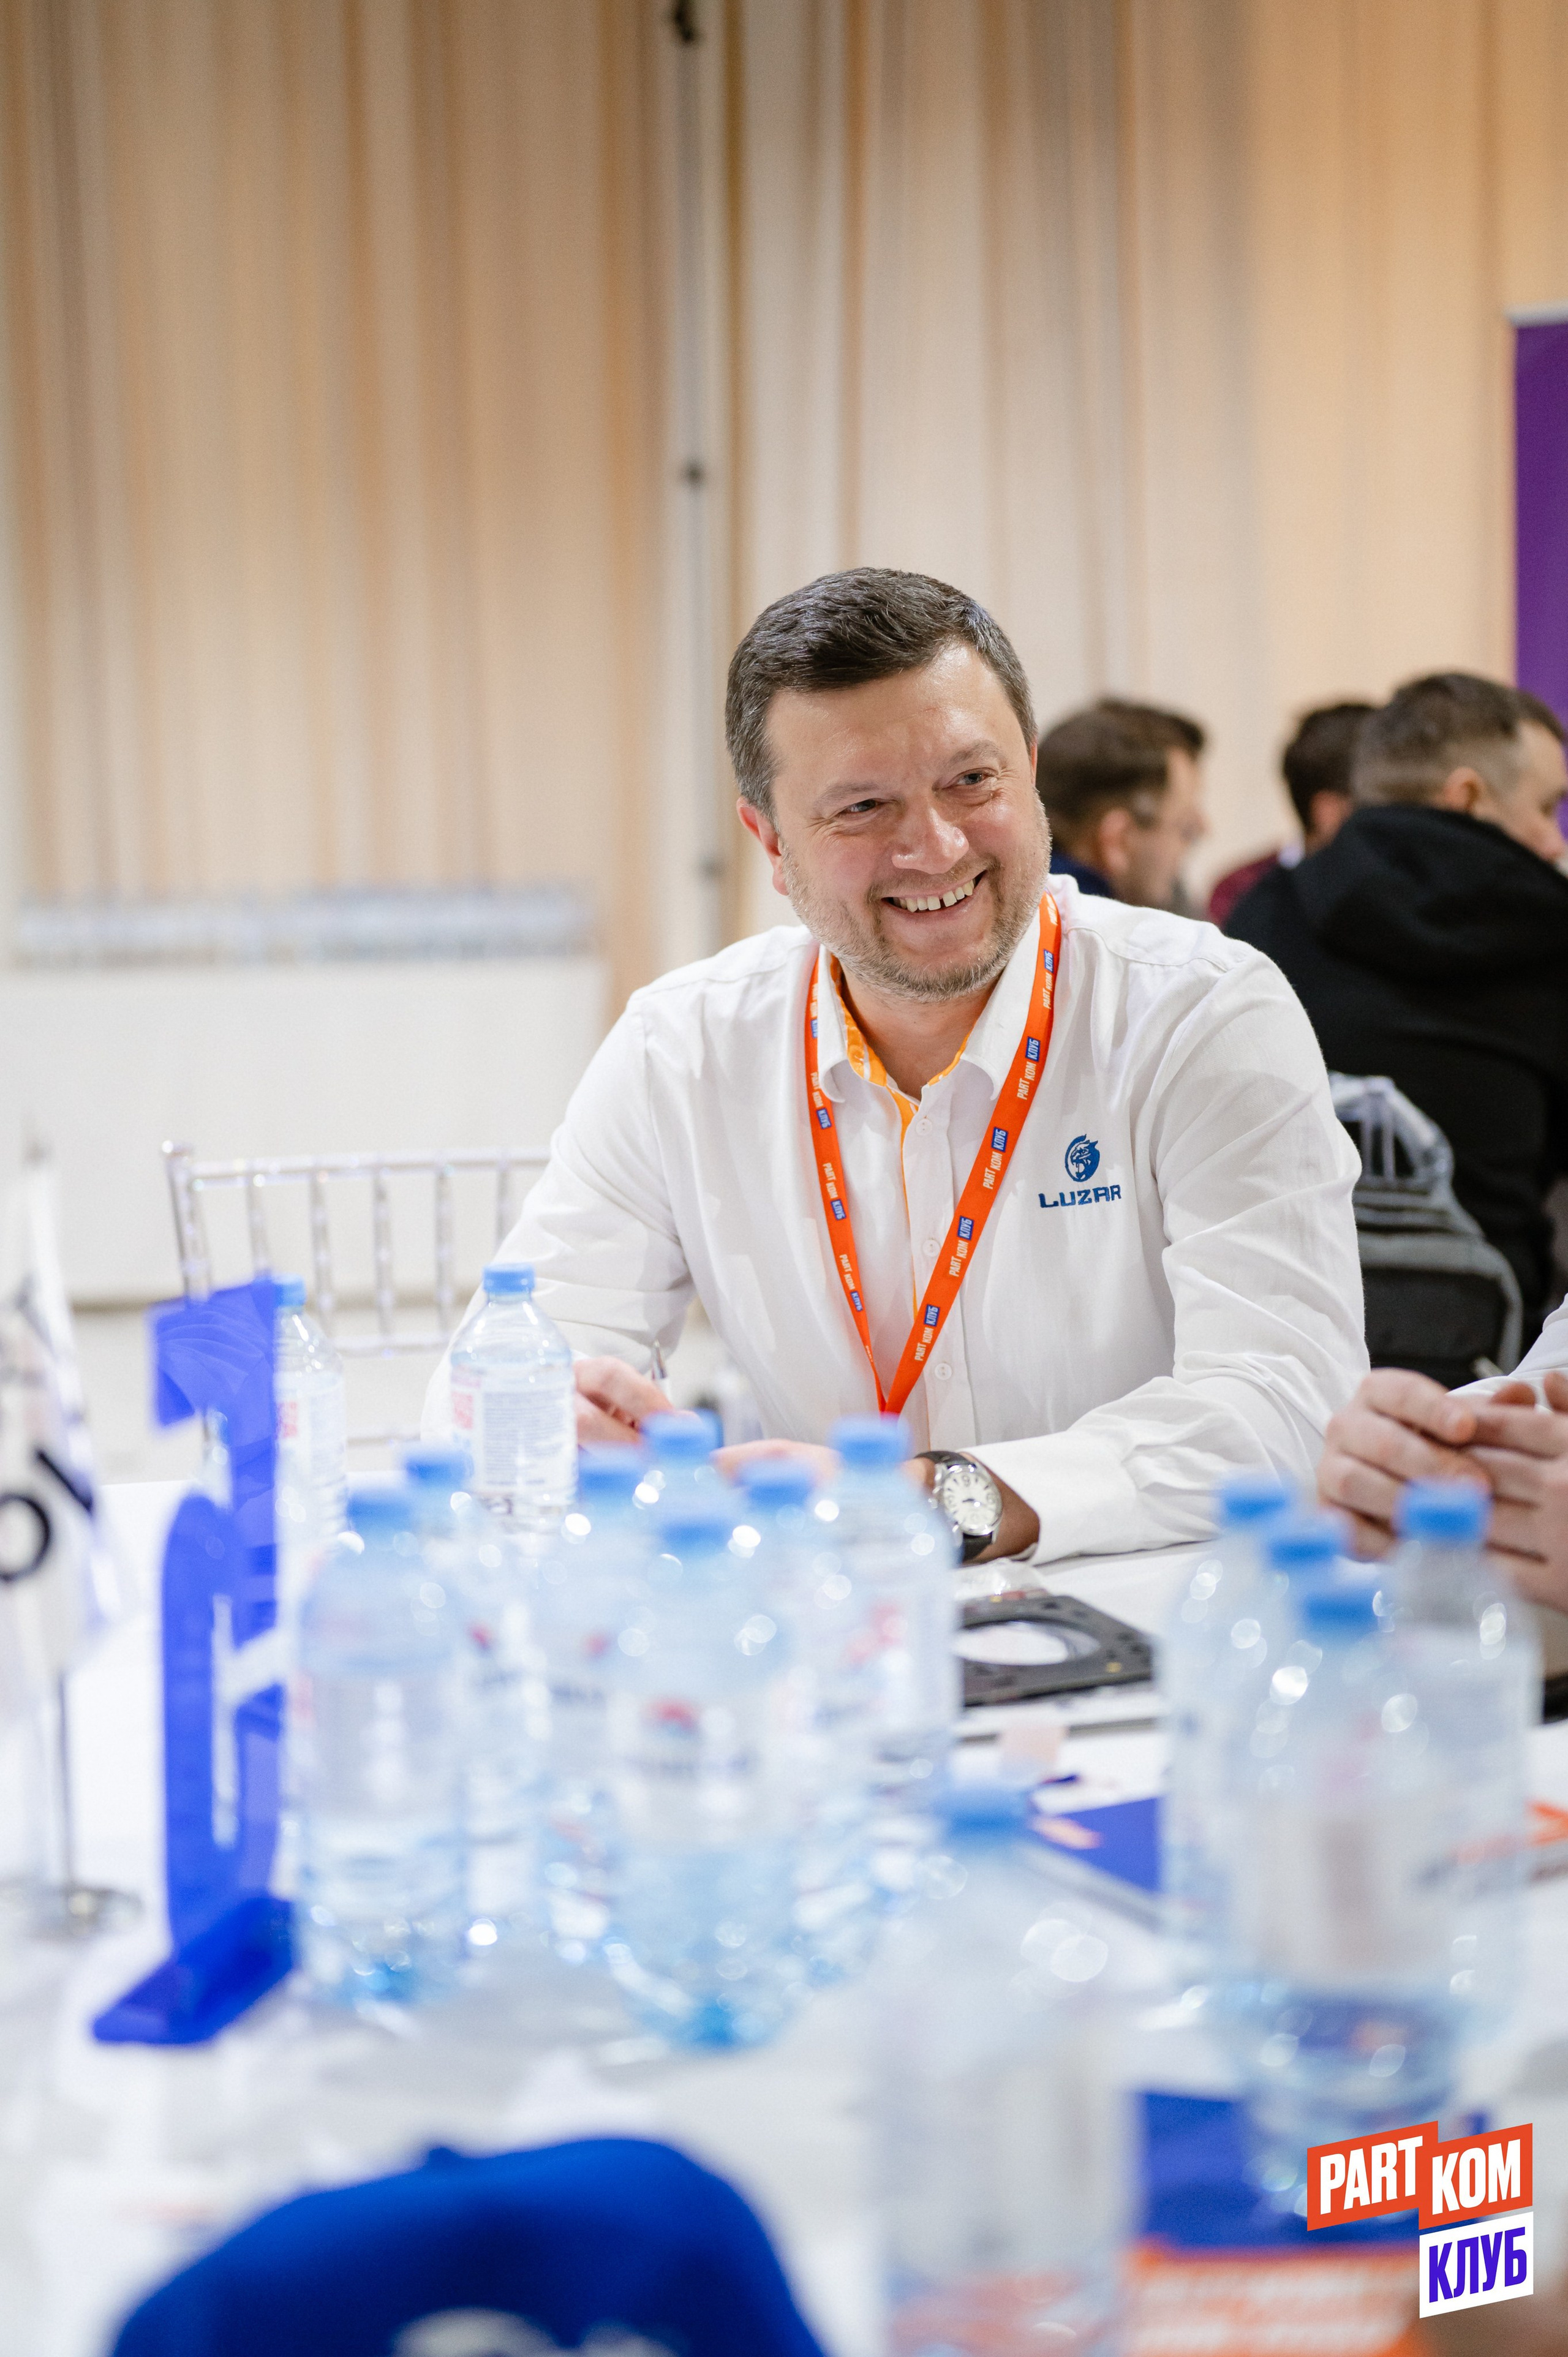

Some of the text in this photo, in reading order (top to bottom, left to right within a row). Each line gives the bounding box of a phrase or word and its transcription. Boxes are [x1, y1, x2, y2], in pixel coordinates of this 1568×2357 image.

[1017, 1077, 1030, 1101] PART
[1027, 1038, 1039, 1060] КЛУБ
[982, 1167, 996, 1190] PART
[993, 1128, 1006, 1150] КЛУБ
[1038, 1184, 1122, 1209] LUZAR
[949, 1256, 962, 1278] PART
[959, 1218, 973, 1239] КЛУБ
[839, 1253, 853, 1273] PART
[851, 1292, 863, 1311] КЛУБ
[914, 1342, 927, 1362] PART
[925, 1305, 939, 1326] КЛУБ
